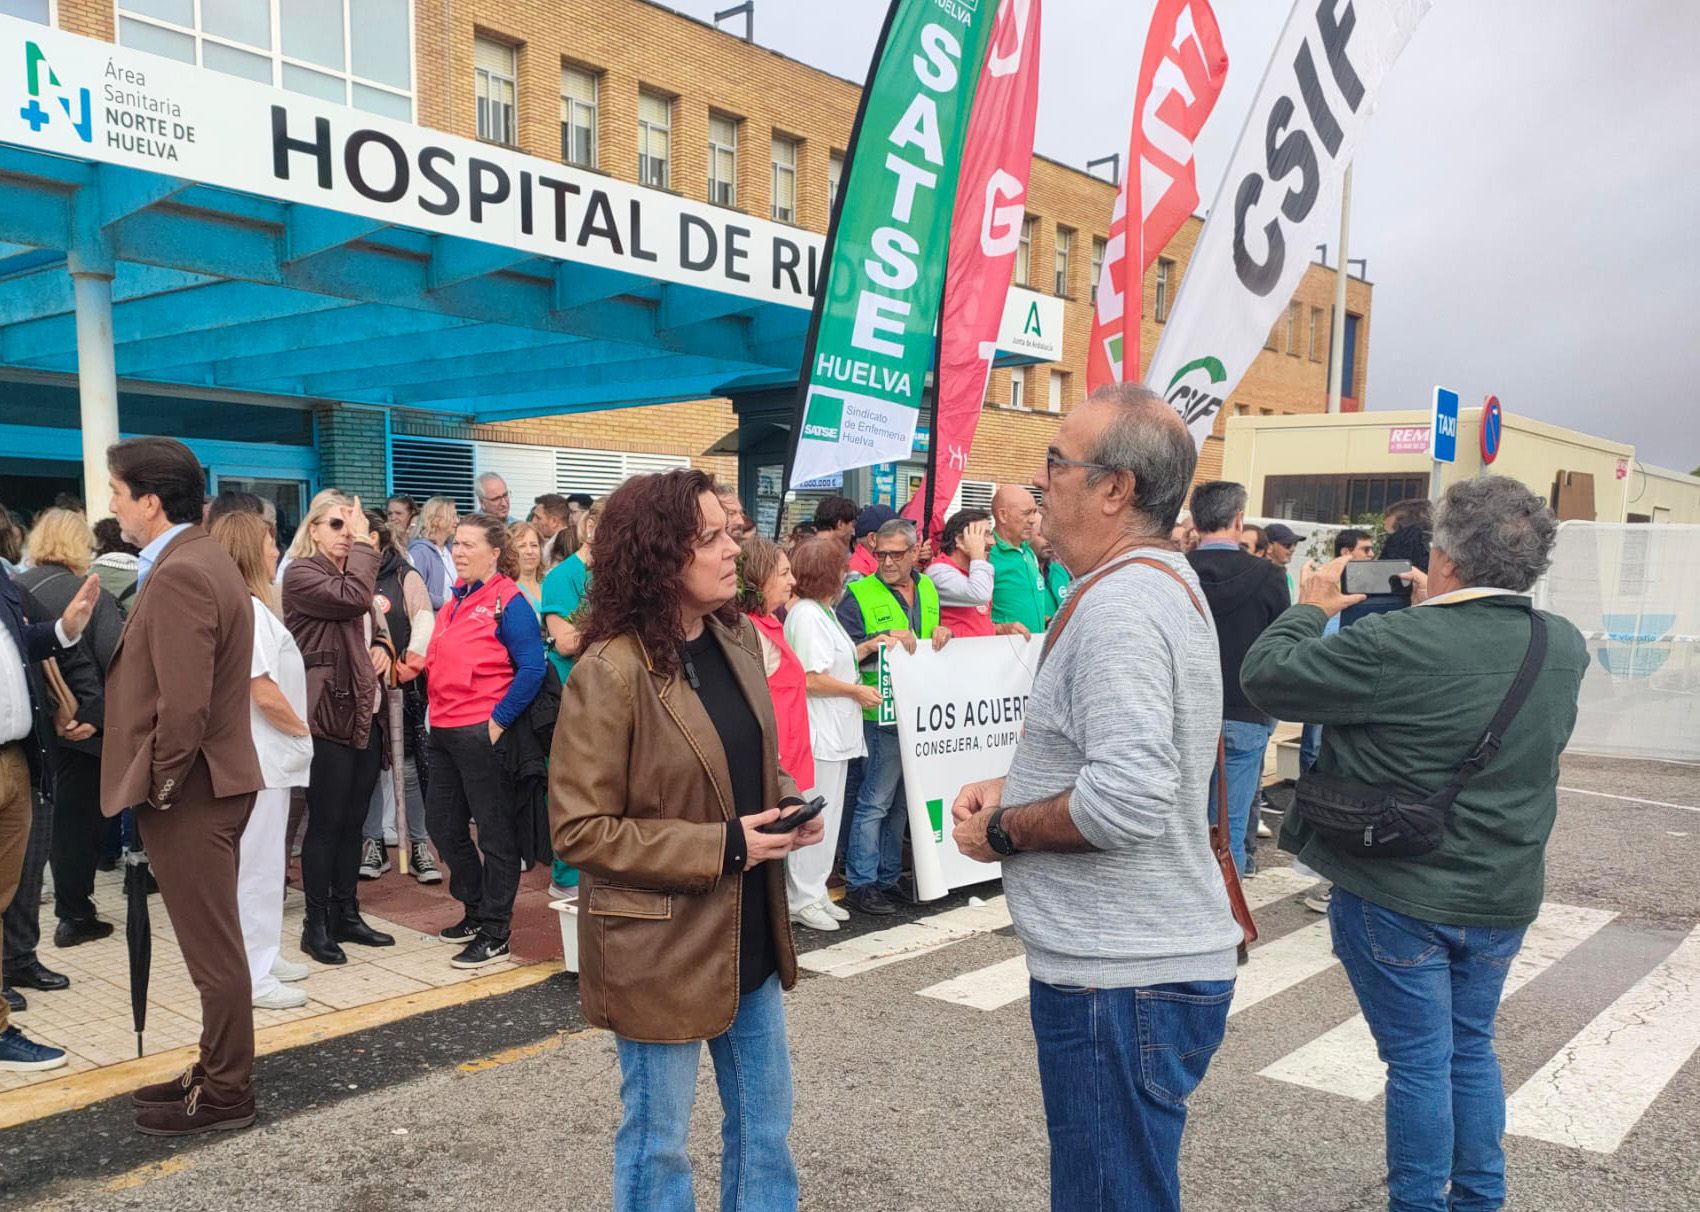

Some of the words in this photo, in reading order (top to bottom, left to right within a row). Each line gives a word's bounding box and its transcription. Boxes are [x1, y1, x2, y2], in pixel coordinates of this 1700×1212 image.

[934, 0, 972, 27] UELVA
[104, 56, 146, 87] Área
[104, 84, 181, 118] Sanitaria
[105, 107, 167, 136] NORTE
[173, 122, 196, 144] DE
[107, 130, 178, 161] HUELVA
[1233, 0, 1366, 297] CSIF
[271, 104, 657, 263] HOSPITAL
[680, 212, 750, 283] DE
[851, 23, 962, 359] SATSE
[816, 353, 911, 397] HUELVA
[846, 405, 888, 424] Sindicato
[1438, 413, 1456, 437] TAXI
[804, 424, 839, 440] SATSE
[842, 431, 875, 448] Huelva
[844, 420, 856, 430] de
[857, 420, 907, 442] Enfermería
[1391, 429, 1430, 442] REM
[916, 702, 956, 733] LOS
[915, 736, 983, 758] CONSEJERA,
[986, 731, 1019, 748] CUMPL
